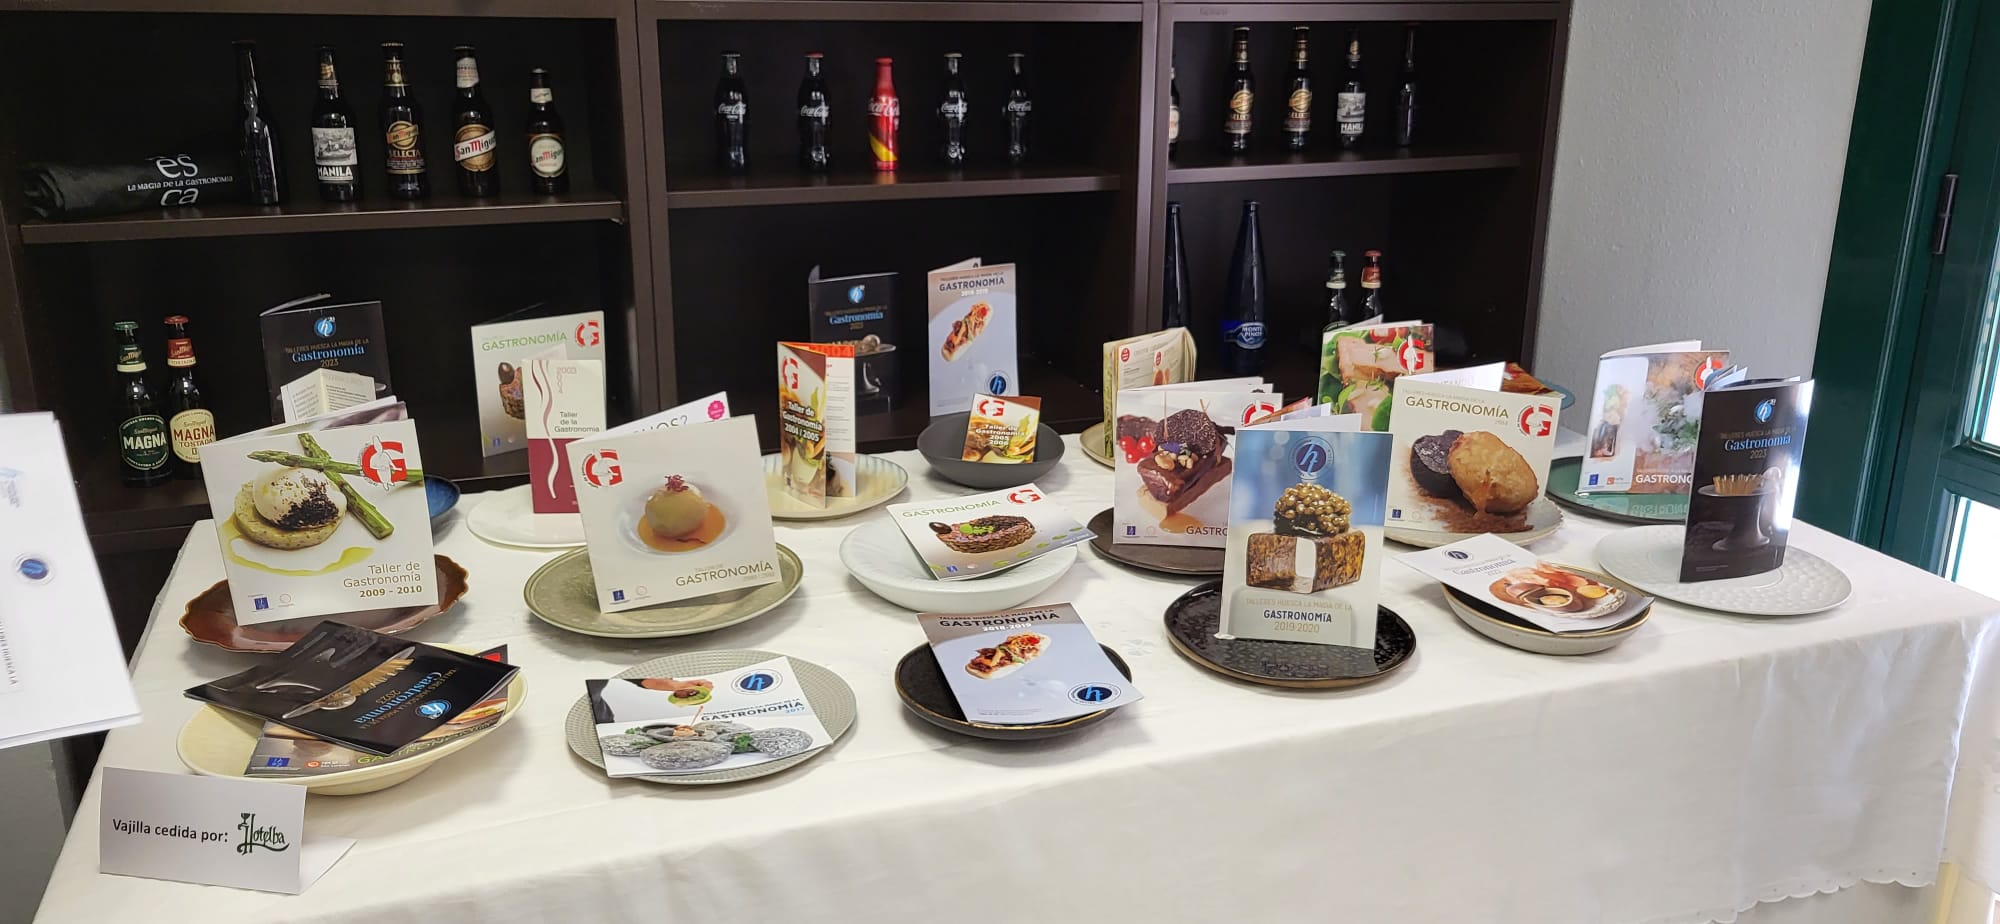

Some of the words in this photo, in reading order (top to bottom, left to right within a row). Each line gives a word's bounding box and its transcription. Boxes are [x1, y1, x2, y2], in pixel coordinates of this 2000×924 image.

[292, 344, 365, 362] Gastronomía
[788, 401, 805, 414] Taller
[805, 406, 815, 417] de
[1405, 396, 1509, 418] GASTRONOMÍA
[123, 432, 166, 450] MAGNA
[174, 424, 214, 441] MAGNA
[1724, 432, 1792, 451] Gastronomía
[1635, 474, 1692, 484] GASTRONO
[902, 500, 1000, 518] GASTRONOMÍA
[1186, 525, 1228, 537] GASTRO
[368, 563, 401, 576] Taller
[405, 560, 421, 572] de
[676, 560, 774, 586] GASTRONOMÍA
[343, 572, 422, 588] Gastronomía
[359, 588, 386, 598] 2009
[397, 585, 422, 595] 2010
[940, 612, 1060, 627] GASTRONOMÍA
[1264, 609, 1332, 623] GASTRONOMÍA
[983, 622, 1032, 632] 2018-2019
[353, 671, 442, 724] Gastronomía
[376, 690, 401, 704] 2023
[700, 702, 804, 721] GASTRONOMÍA
[112, 818, 151, 835] Vajilla
[154, 824, 198, 840] cedida
[201, 831, 229, 844] por:
[236, 813, 290, 855] Hotelba
